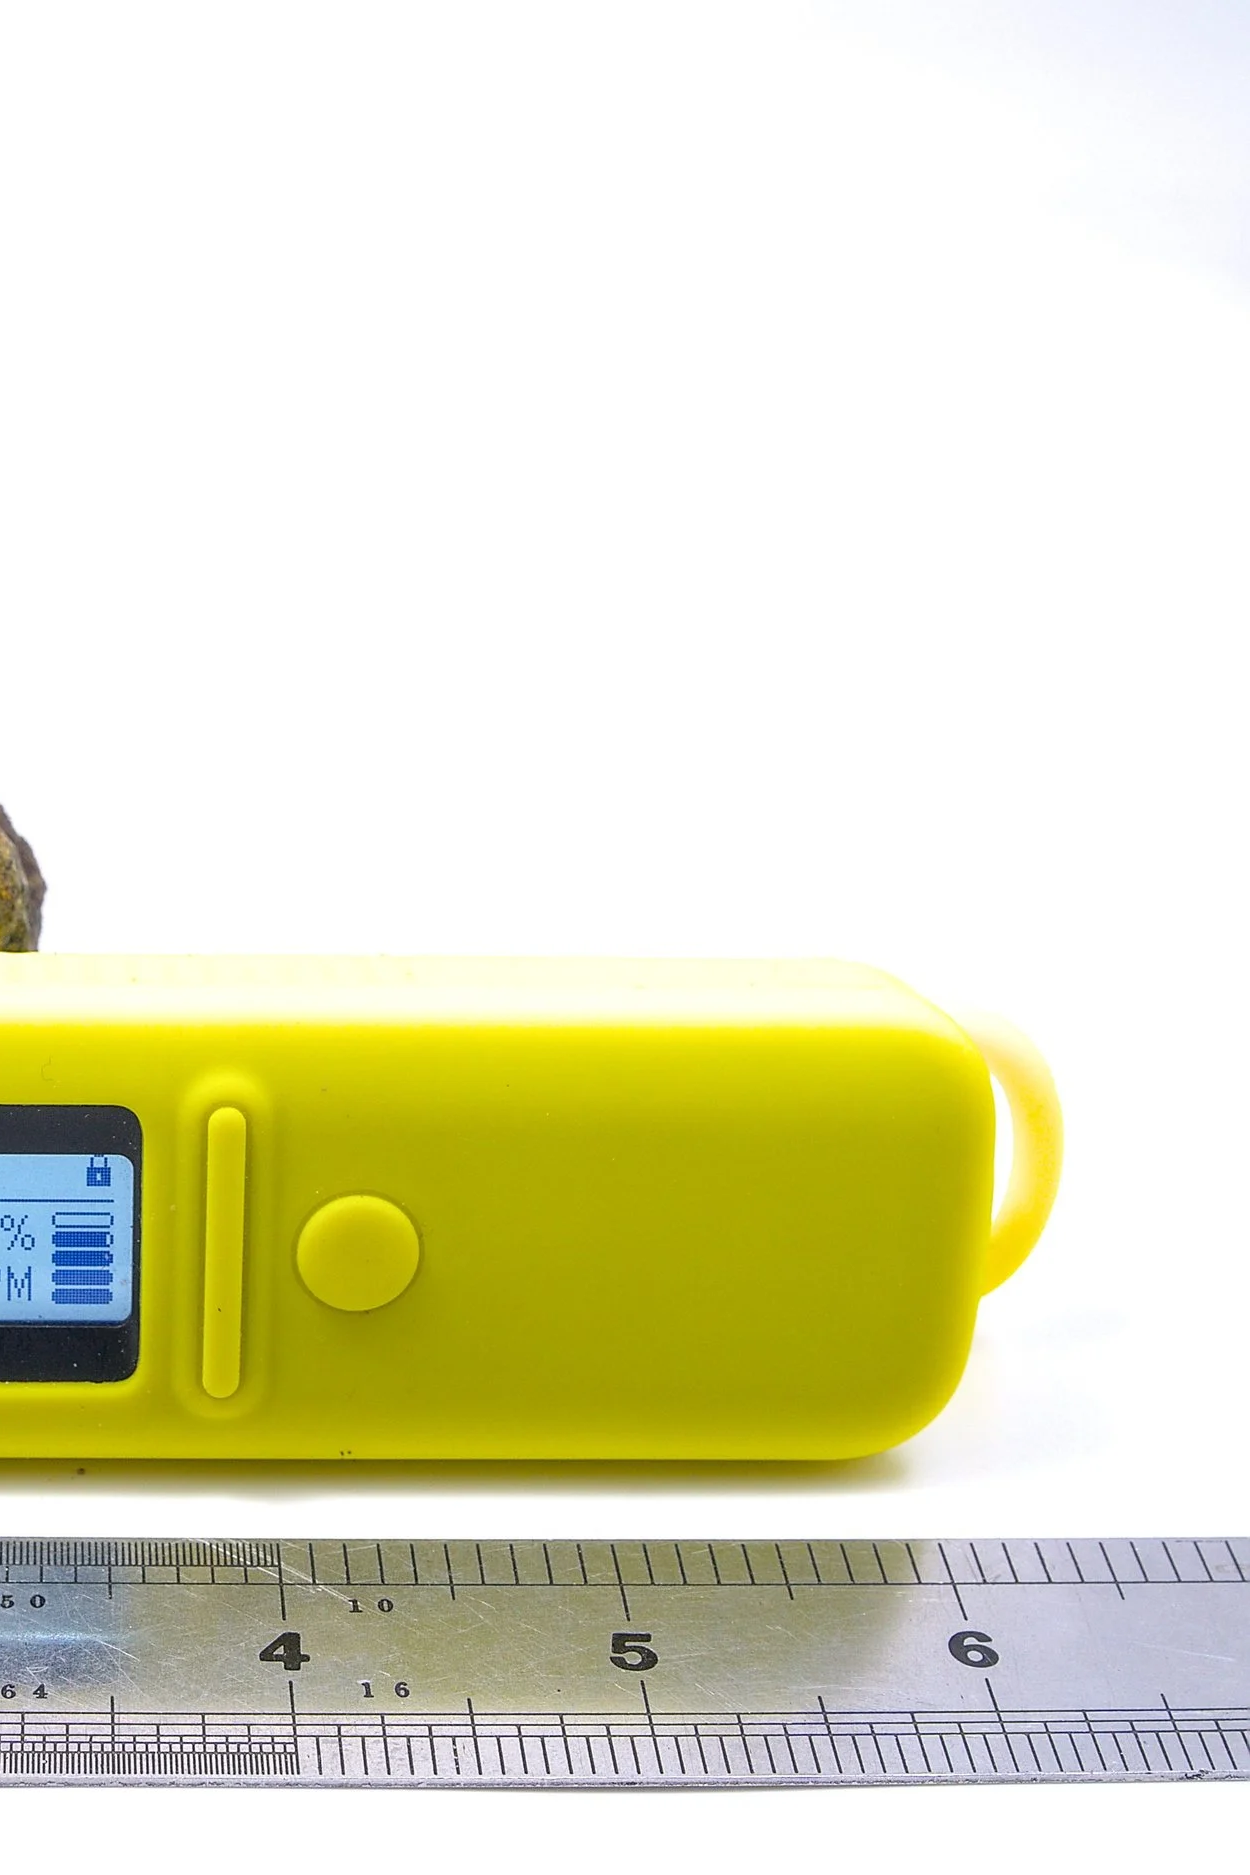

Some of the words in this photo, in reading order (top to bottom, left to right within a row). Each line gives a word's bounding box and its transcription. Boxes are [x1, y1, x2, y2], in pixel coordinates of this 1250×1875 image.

[258, 1631, 311, 1672] 4
[609, 1632, 659, 1672] 5
[948, 1630, 1000, 1669] 6
